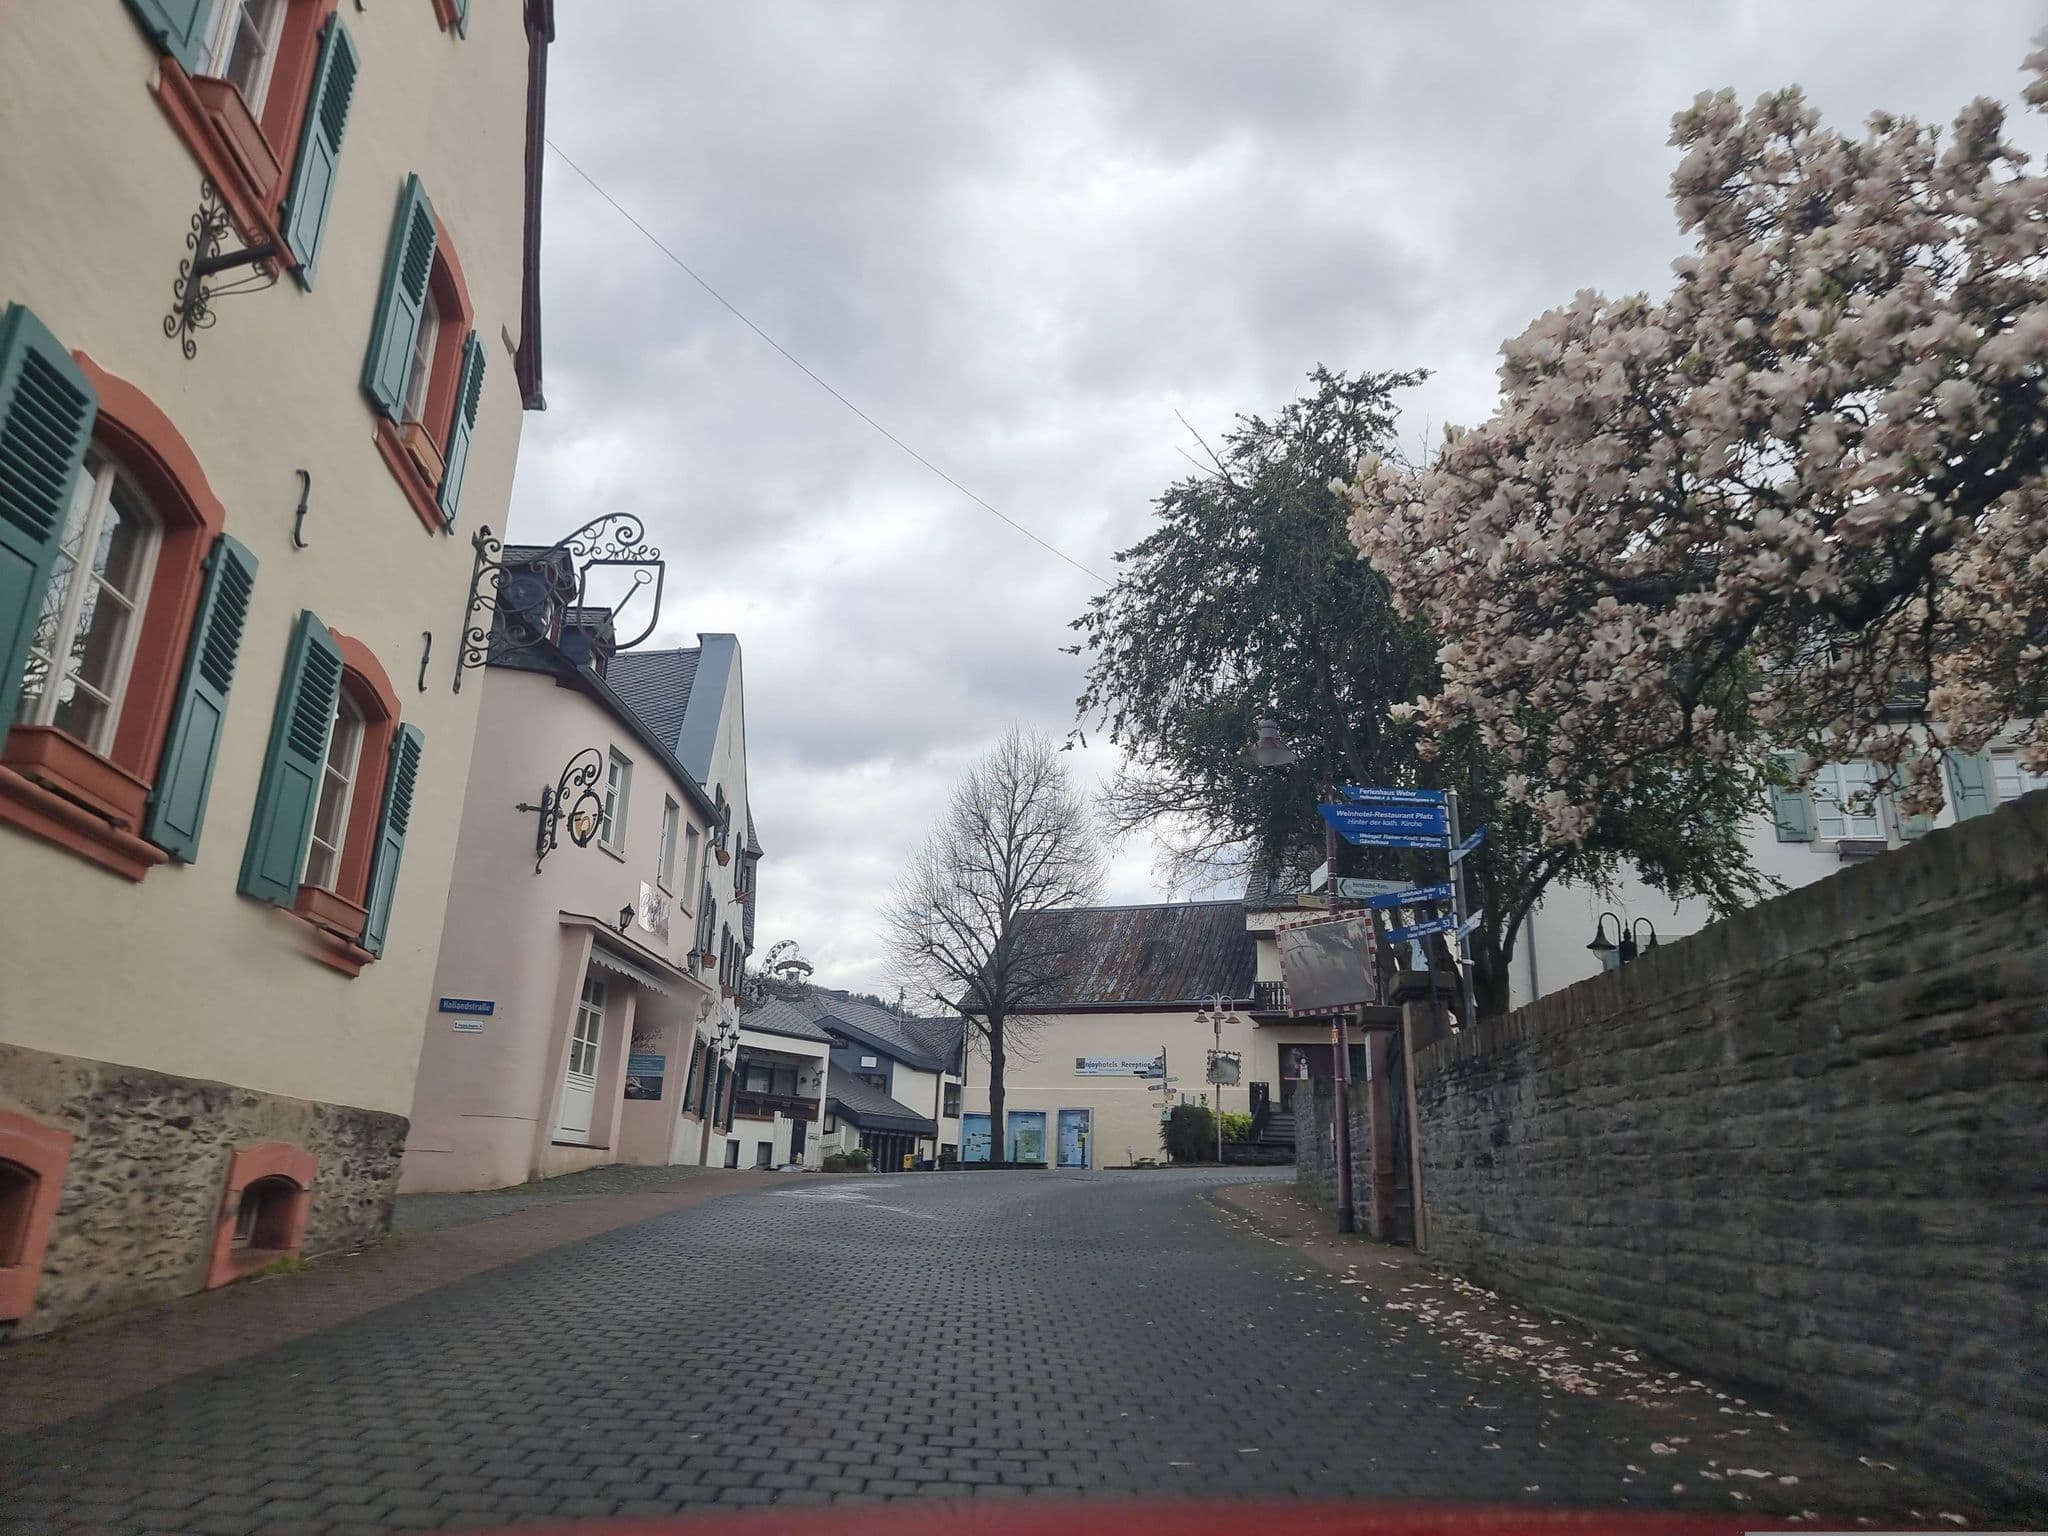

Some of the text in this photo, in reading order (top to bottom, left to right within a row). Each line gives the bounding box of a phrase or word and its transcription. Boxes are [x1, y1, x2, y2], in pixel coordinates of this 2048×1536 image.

[1359, 788, 1417, 797] Ferienhaus Weber
[1336, 810, 1434, 820] Weinhotel-Restaurant Platz
[443, 1000, 491, 1011] Hollandstraße
